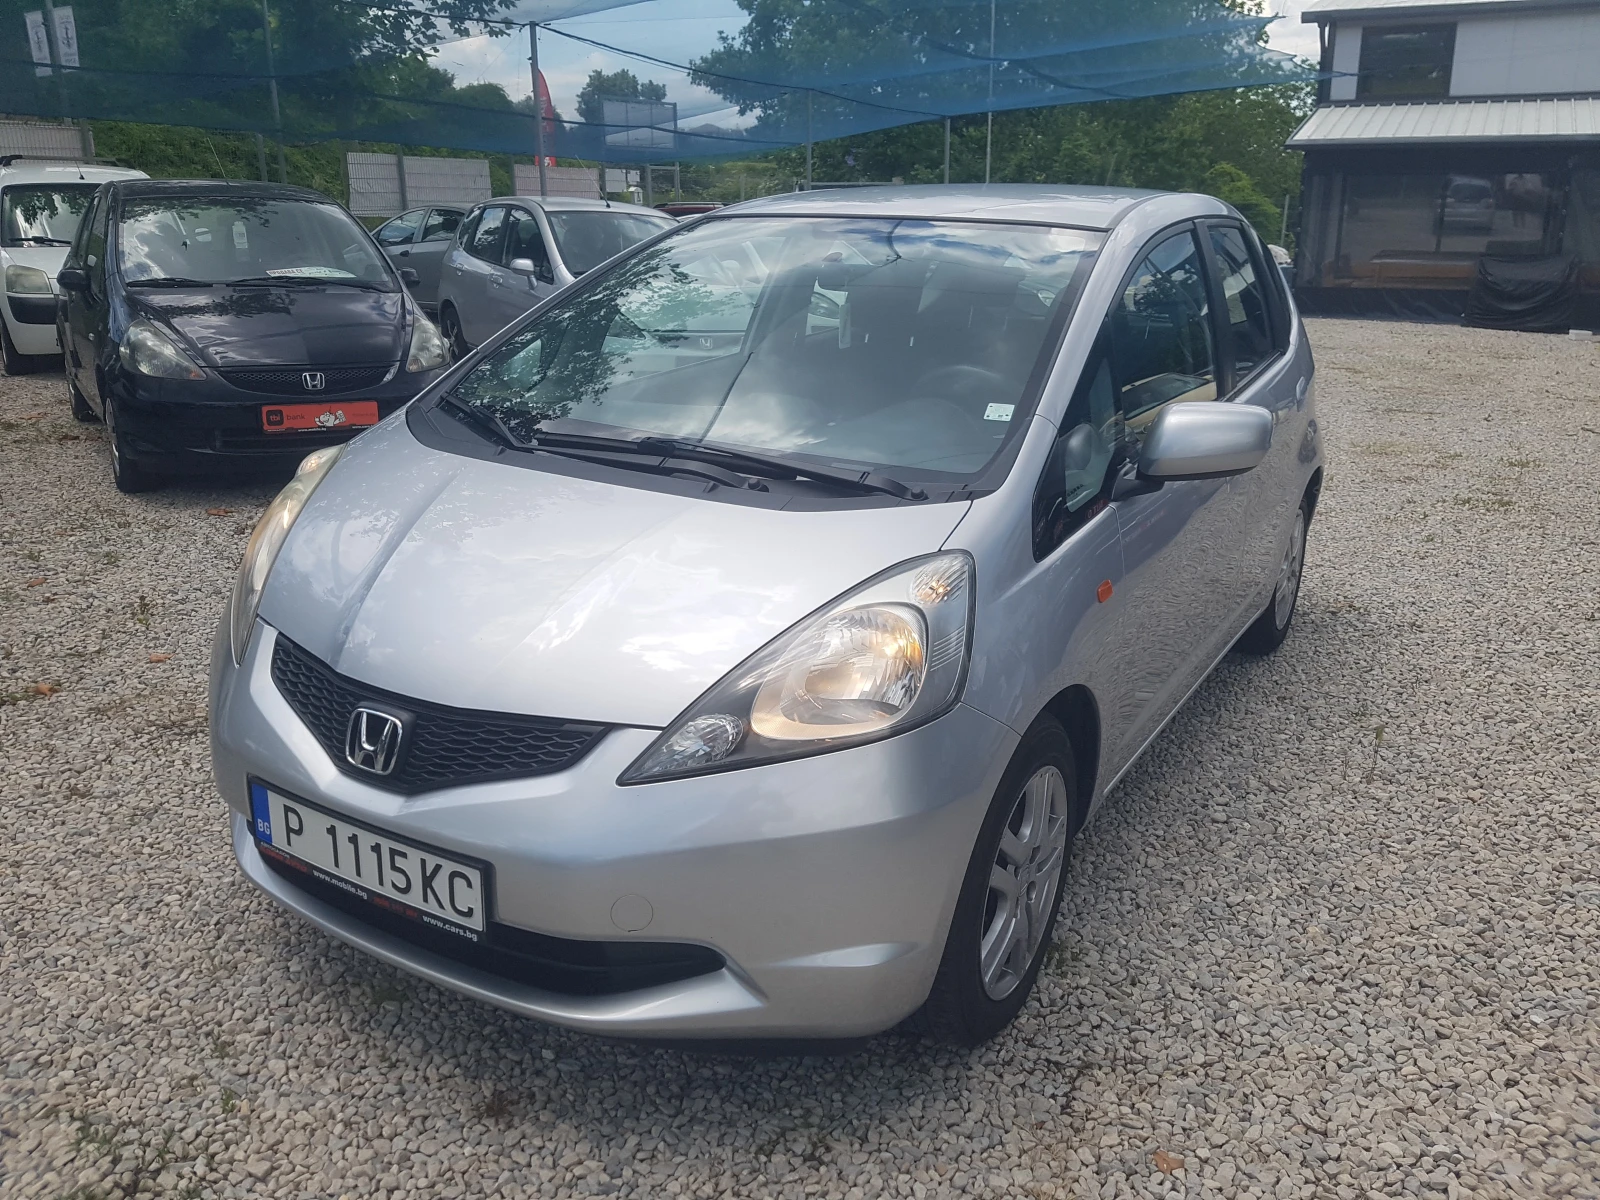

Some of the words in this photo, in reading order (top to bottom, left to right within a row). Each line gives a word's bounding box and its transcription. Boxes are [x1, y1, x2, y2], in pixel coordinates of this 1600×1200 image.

[286, 413, 306, 421] bank
[257, 818, 271, 835] BG
[283, 803, 304, 847] P
[312, 869, 368, 900] www.mobile.bg
[422, 914, 478, 942] www.cars.bg
